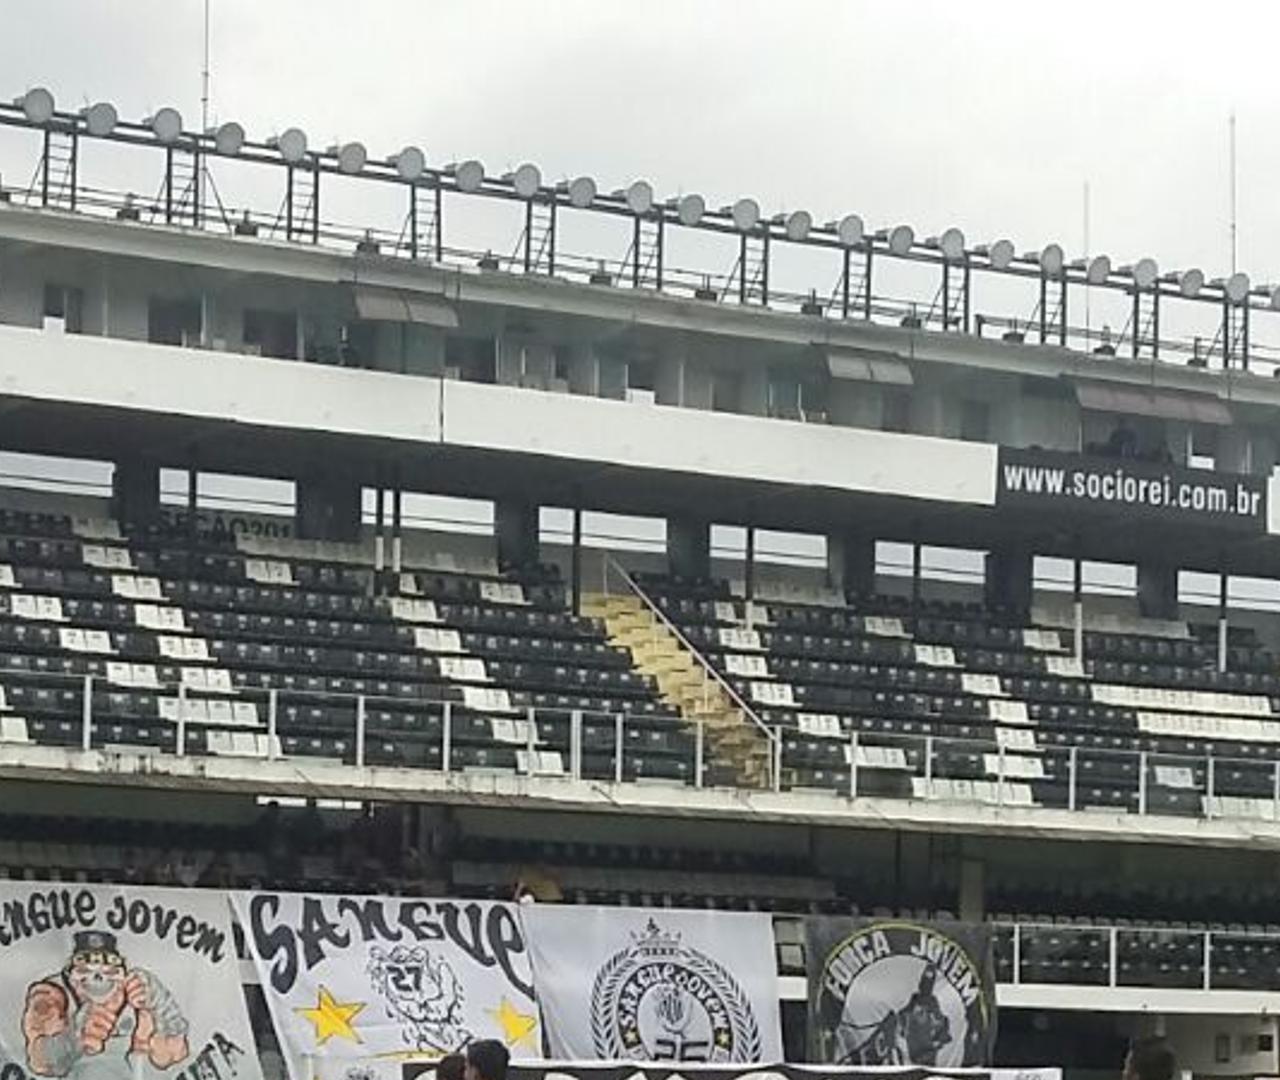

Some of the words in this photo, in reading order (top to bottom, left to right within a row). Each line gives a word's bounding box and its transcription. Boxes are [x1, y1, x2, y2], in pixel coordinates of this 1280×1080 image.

[1004, 464, 1261, 516] www.sociorei.com.br
[385, 965, 422, 992] 27
[910, 932, 980, 1006] JOVEM
